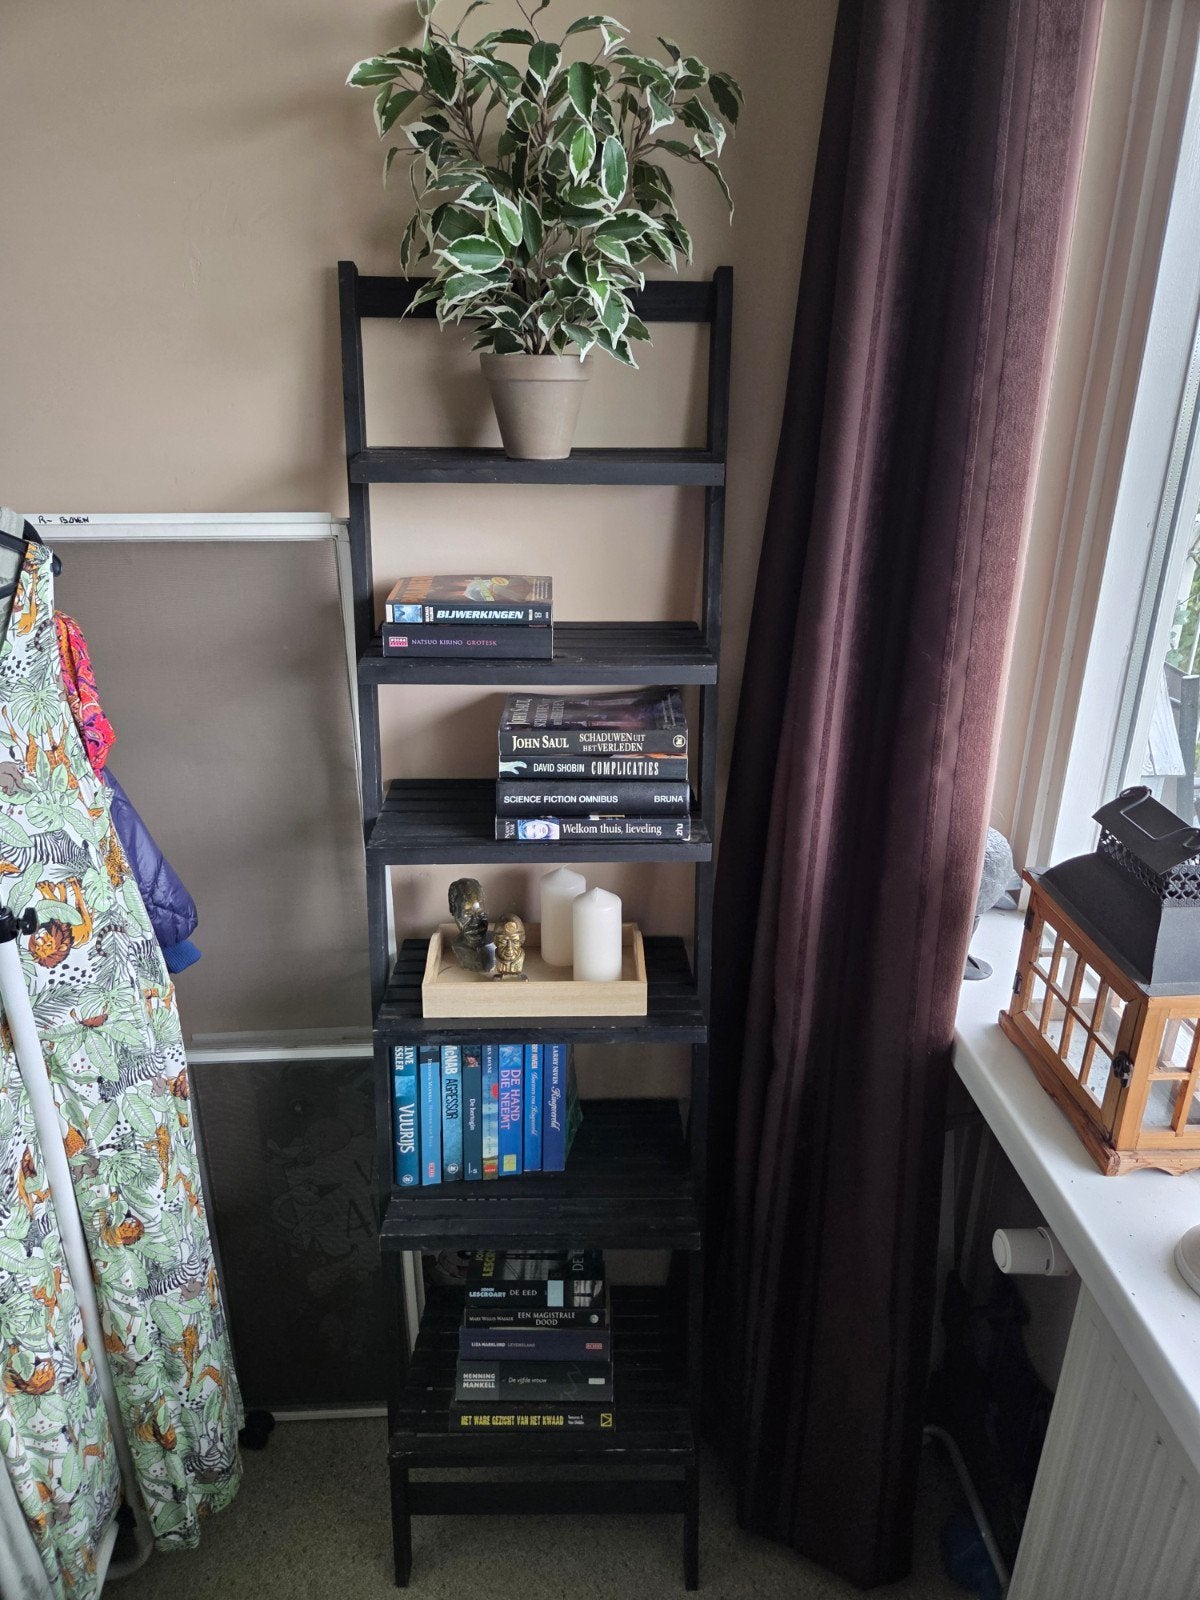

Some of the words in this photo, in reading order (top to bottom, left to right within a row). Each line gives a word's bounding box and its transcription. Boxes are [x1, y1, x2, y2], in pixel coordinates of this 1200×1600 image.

[436, 610, 524, 619] BIJWERKINGEN
[512, 735, 540, 751] JOHN
[541, 735, 570, 749] SAUL
[579, 732, 633, 743] SCHADUWEN
[633, 734, 646, 742] UIT
[582, 744, 597, 752] HET
[597, 742, 643, 752] VERLEDEN
[533, 763, 555, 772] DAVID
[556, 763, 585, 773] SHOBIN
[591, 761, 659, 776] COMPLICATIES
[503, 795, 541, 803] SCIENCE
[543, 795, 577, 803] FICTION
[579, 795, 618, 803] OMNIBUS
[654, 795, 684, 803] BRUNA
[562, 823, 598, 834] Welkom
[600, 823, 624, 835] thuis,
[625, 822, 662, 836] lieveling
[394, 1046, 404, 1070] SSLER
[405, 1046, 414, 1065] LIVE
[500, 1069, 511, 1089] DIE
[511, 1069, 522, 1086] DE
[445, 1078, 459, 1120] AGRESSOR
[469, 1098, 476, 1106] De
[510, 1087, 521, 1122] HAND
[500, 1091, 511, 1130] NEEMT
[549, 1086, 561, 1131] Ringwereld
[398, 1103, 415, 1154] VUURIJS
[533, 1311, 575, 1319] MAGISTRALE
[460, 1415, 473, 1426] HET
[473, 1415, 491, 1426] WARE
[492, 1415, 516, 1426] GEZICHT
[516, 1415, 529, 1426] VAN
[529, 1415, 541, 1426] HET
[542, 1415, 564, 1426] KWAAD
